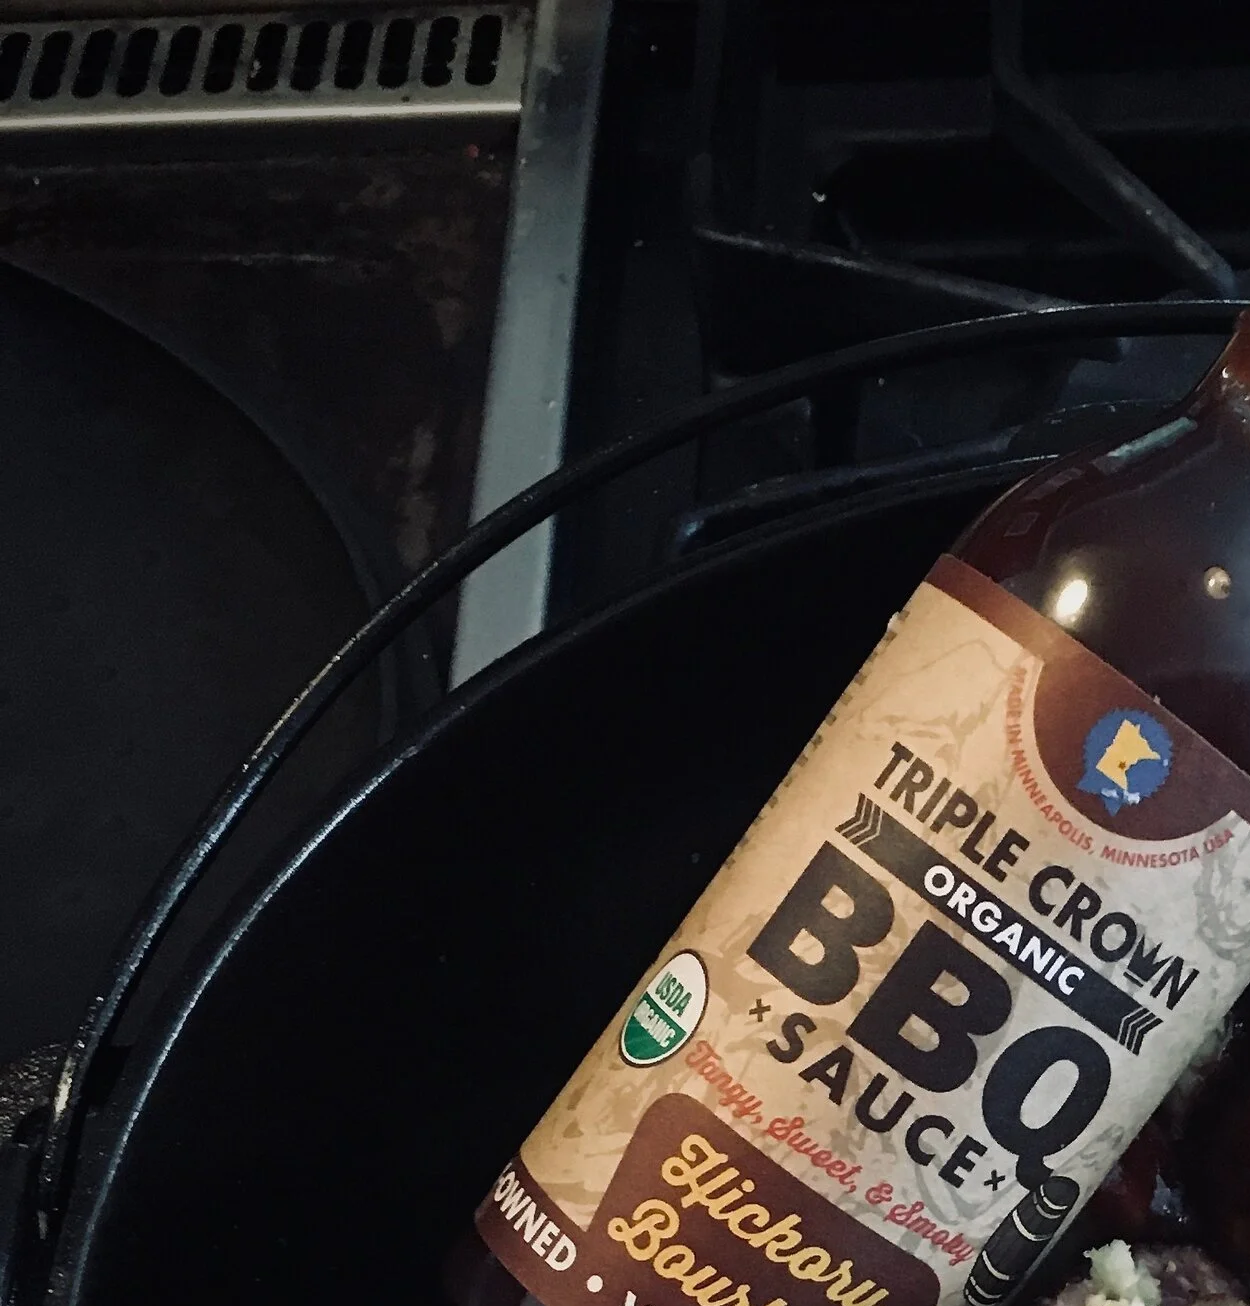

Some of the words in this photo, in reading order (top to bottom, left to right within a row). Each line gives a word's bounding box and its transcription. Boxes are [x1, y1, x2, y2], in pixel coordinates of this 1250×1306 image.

[1005, 667, 1027, 718] MADE
[1008, 724, 1022, 745] IN
[1011, 750, 1095, 854] MINNEAPOLIS,
[1203, 829, 1234, 853] USA
[874, 741, 1030, 883] TRIPLE
[1028, 865, 1199, 1011] CROWN
[1101, 845, 1199, 868] MINNESOTA
[923, 865, 1085, 996] ORGANIC
[655, 971, 692, 1018] USDA
[746, 840, 1112, 1190] BBQ
[766, 1012, 987, 1189] SAUCE
[685, 1040, 763, 1124] Tangy,
[765, 1116, 863, 1193] Sweet,
[864, 1181, 894, 1205] &
[884, 1201, 975, 1267] Smoky
[494, 1171, 577, 1271] OWNED
